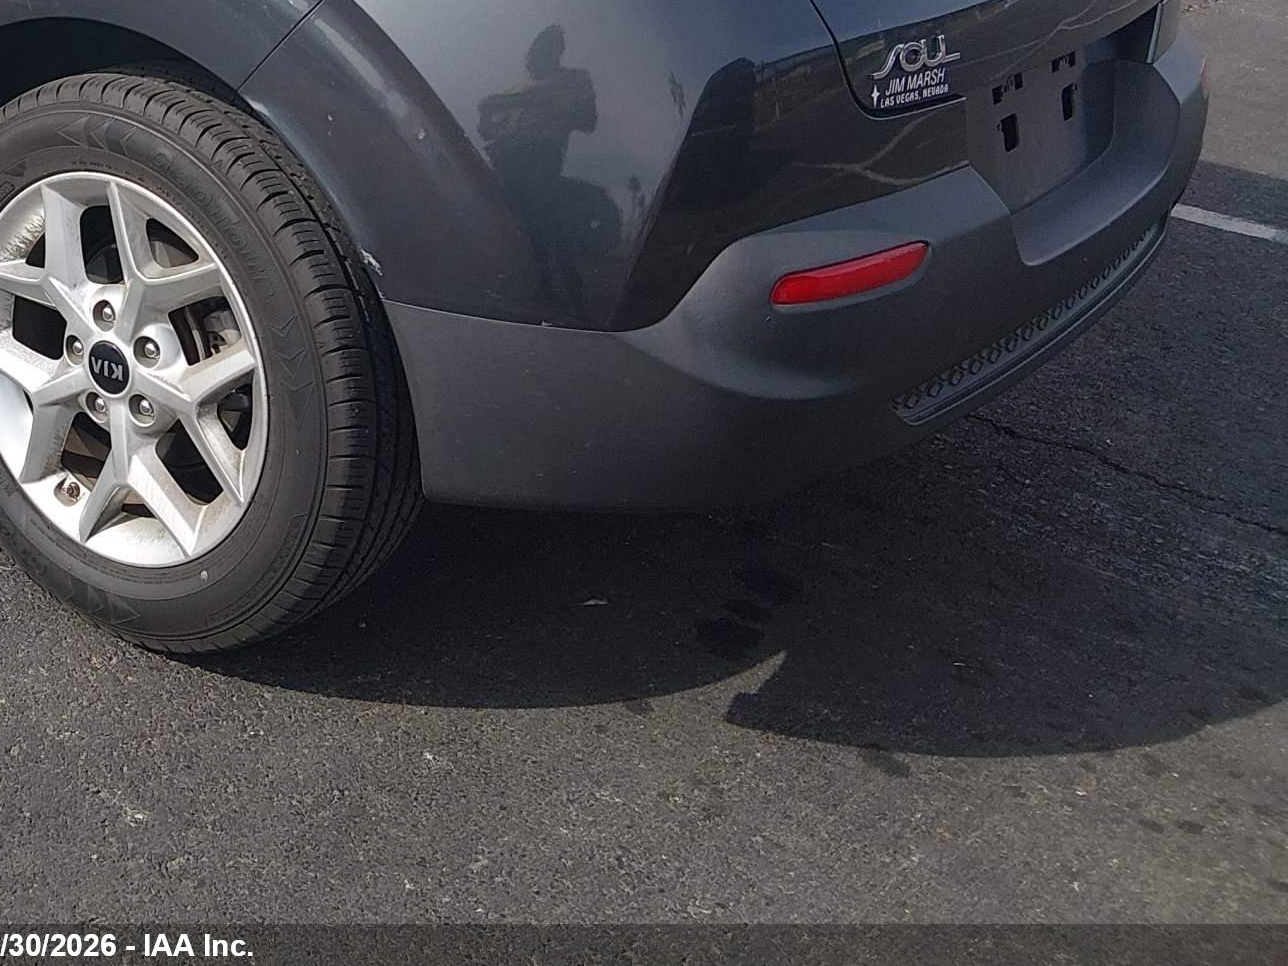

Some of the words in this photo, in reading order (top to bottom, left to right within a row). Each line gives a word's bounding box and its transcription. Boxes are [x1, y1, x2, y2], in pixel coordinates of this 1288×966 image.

[872, 34, 961, 80] SOUL
[885, 76, 906, 96] JIM
[907, 67, 946, 91] MARSH
[880, 96, 896, 109] LAS
[896, 90, 922, 105] VEGAS,
[923, 83, 949, 99] NEVADA
[91, 355, 123, 382] KIA
